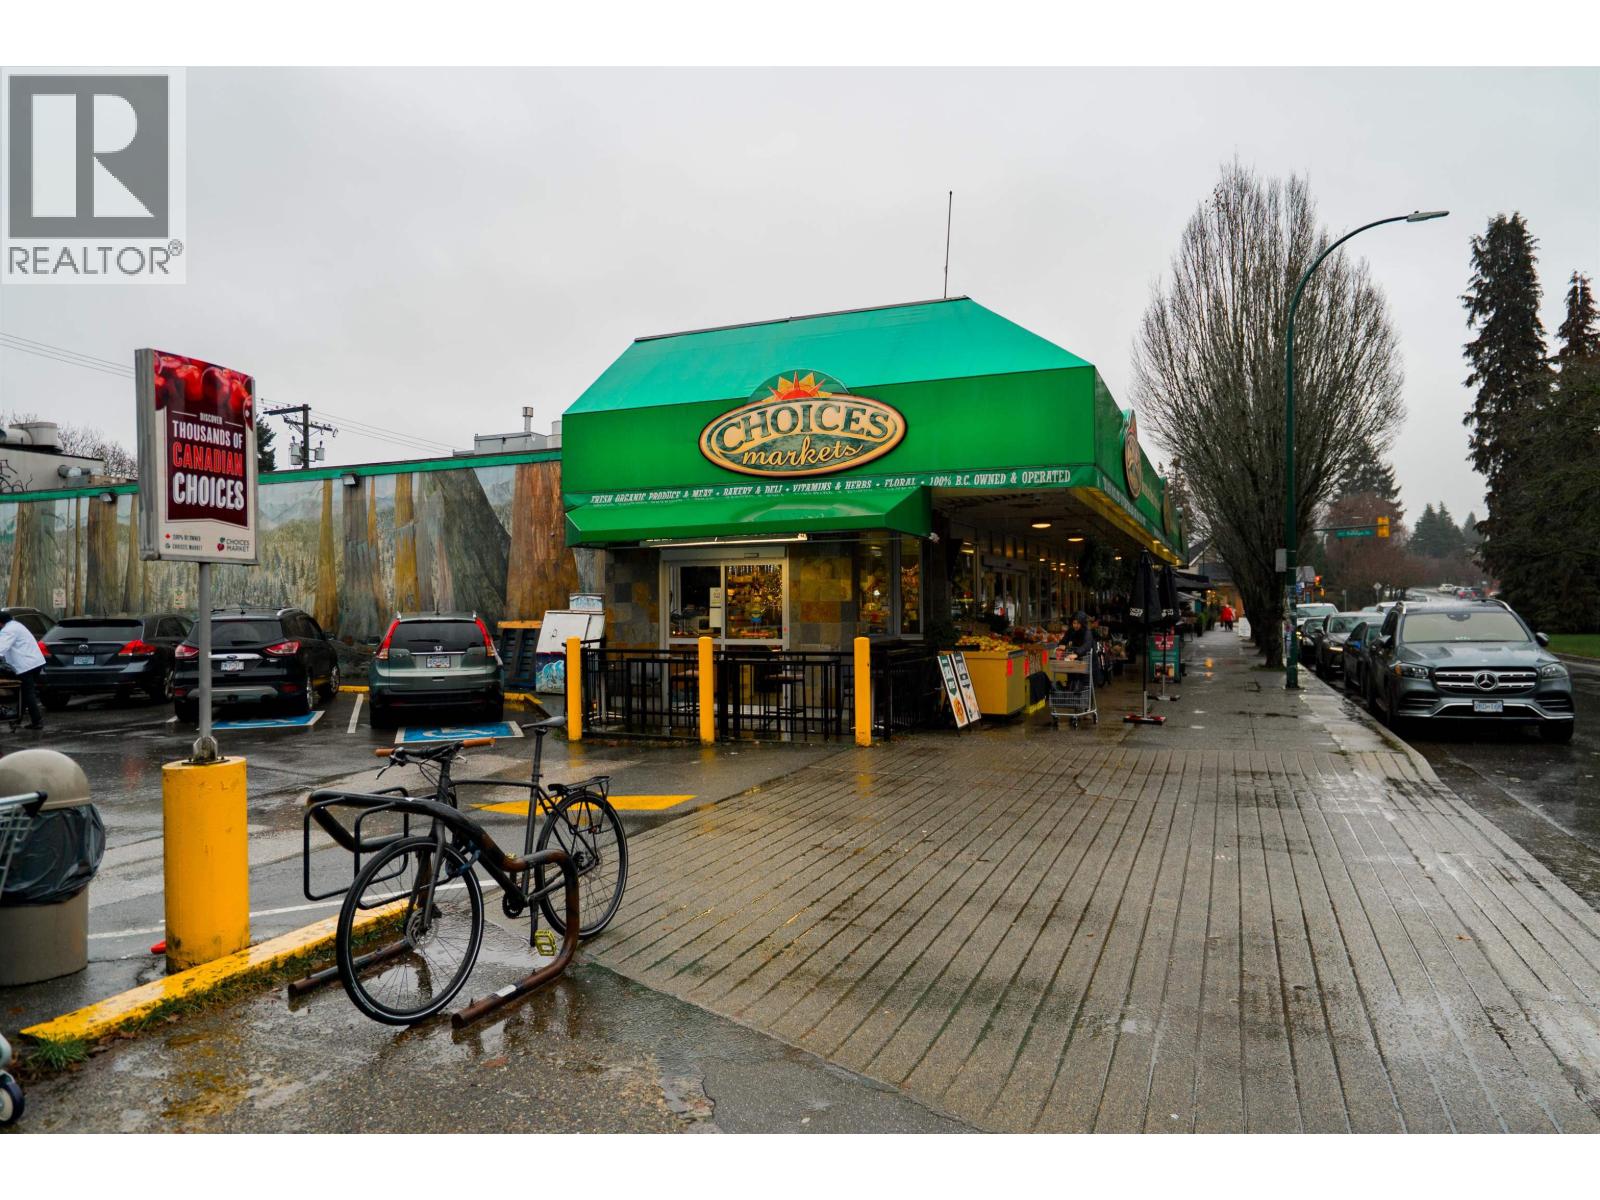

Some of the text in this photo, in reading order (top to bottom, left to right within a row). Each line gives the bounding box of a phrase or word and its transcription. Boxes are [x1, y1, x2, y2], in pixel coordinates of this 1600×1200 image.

[172, 420, 244, 450] THOUSANDS OF
[199, 412, 223, 425] DISCOVER
[714, 403, 890, 452] CHOICES
[172, 441, 244, 477] CANADIAN
[742, 435, 864, 467] markets
[172, 472, 245, 511] CHOICES
[590, 494, 613, 504] FRESH
[615, 492, 646, 503] ORGANIC
[648, 490, 681, 501] PRODUCE
[691, 489, 714, 498] MEAT
[723, 486, 753, 496] BAKERY
[754, 485, 761, 495] &
[765, 484, 783, 494] DELI
[792, 481, 832, 492] VITAMINS
[834, 481, 842, 491] &
[845, 480, 872, 490] HERBS
[884, 477, 916, 488] FLORAL
[929, 476, 951, 487] 100%
[973, 473, 1007, 486] OWNED
[1010, 472, 1017, 484] &
[1021, 469, 1072, 484] OPERATED
[226, 538, 250, 546] CHOICES
